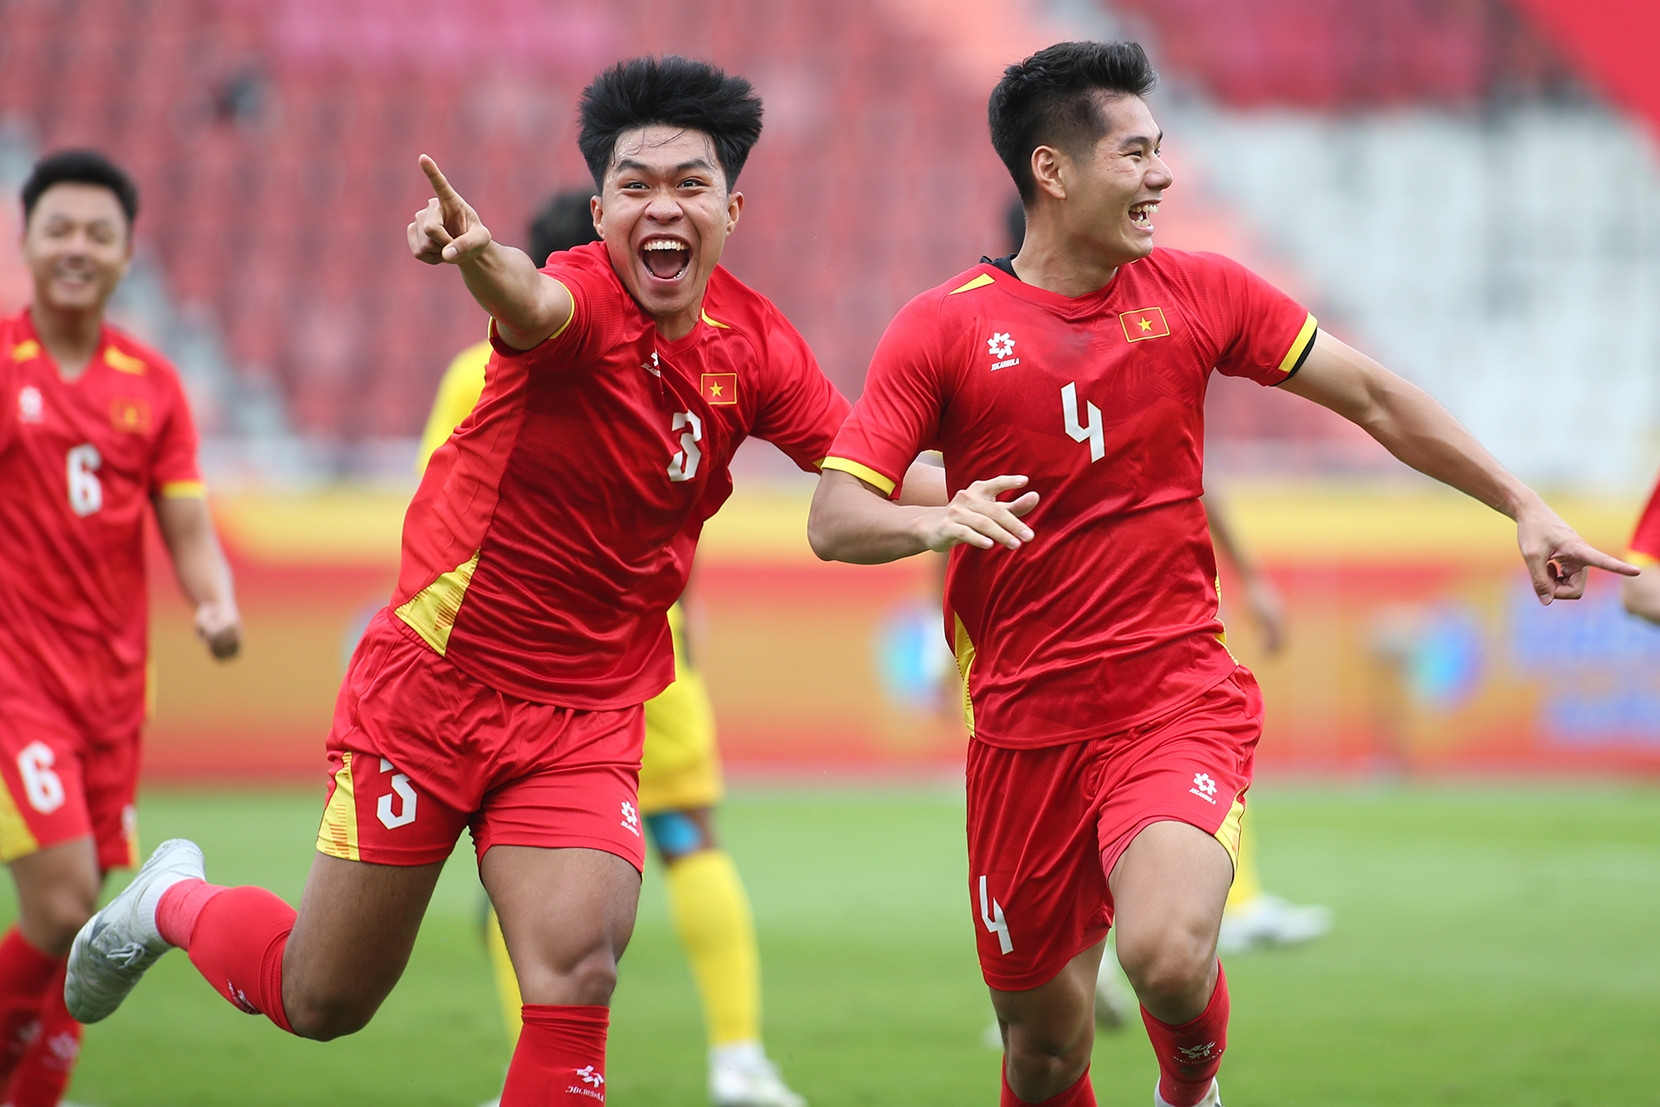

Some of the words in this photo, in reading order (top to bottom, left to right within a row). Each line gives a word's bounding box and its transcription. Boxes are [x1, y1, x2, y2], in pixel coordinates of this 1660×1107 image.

[667, 410, 701, 481] 3
[1061, 382, 1105, 463] 4
[67, 444, 101, 516] 6
[18, 741, 63, 813] 6
[377, 758, 417, 829] 3
[980, 875, 1013, 954] 4
